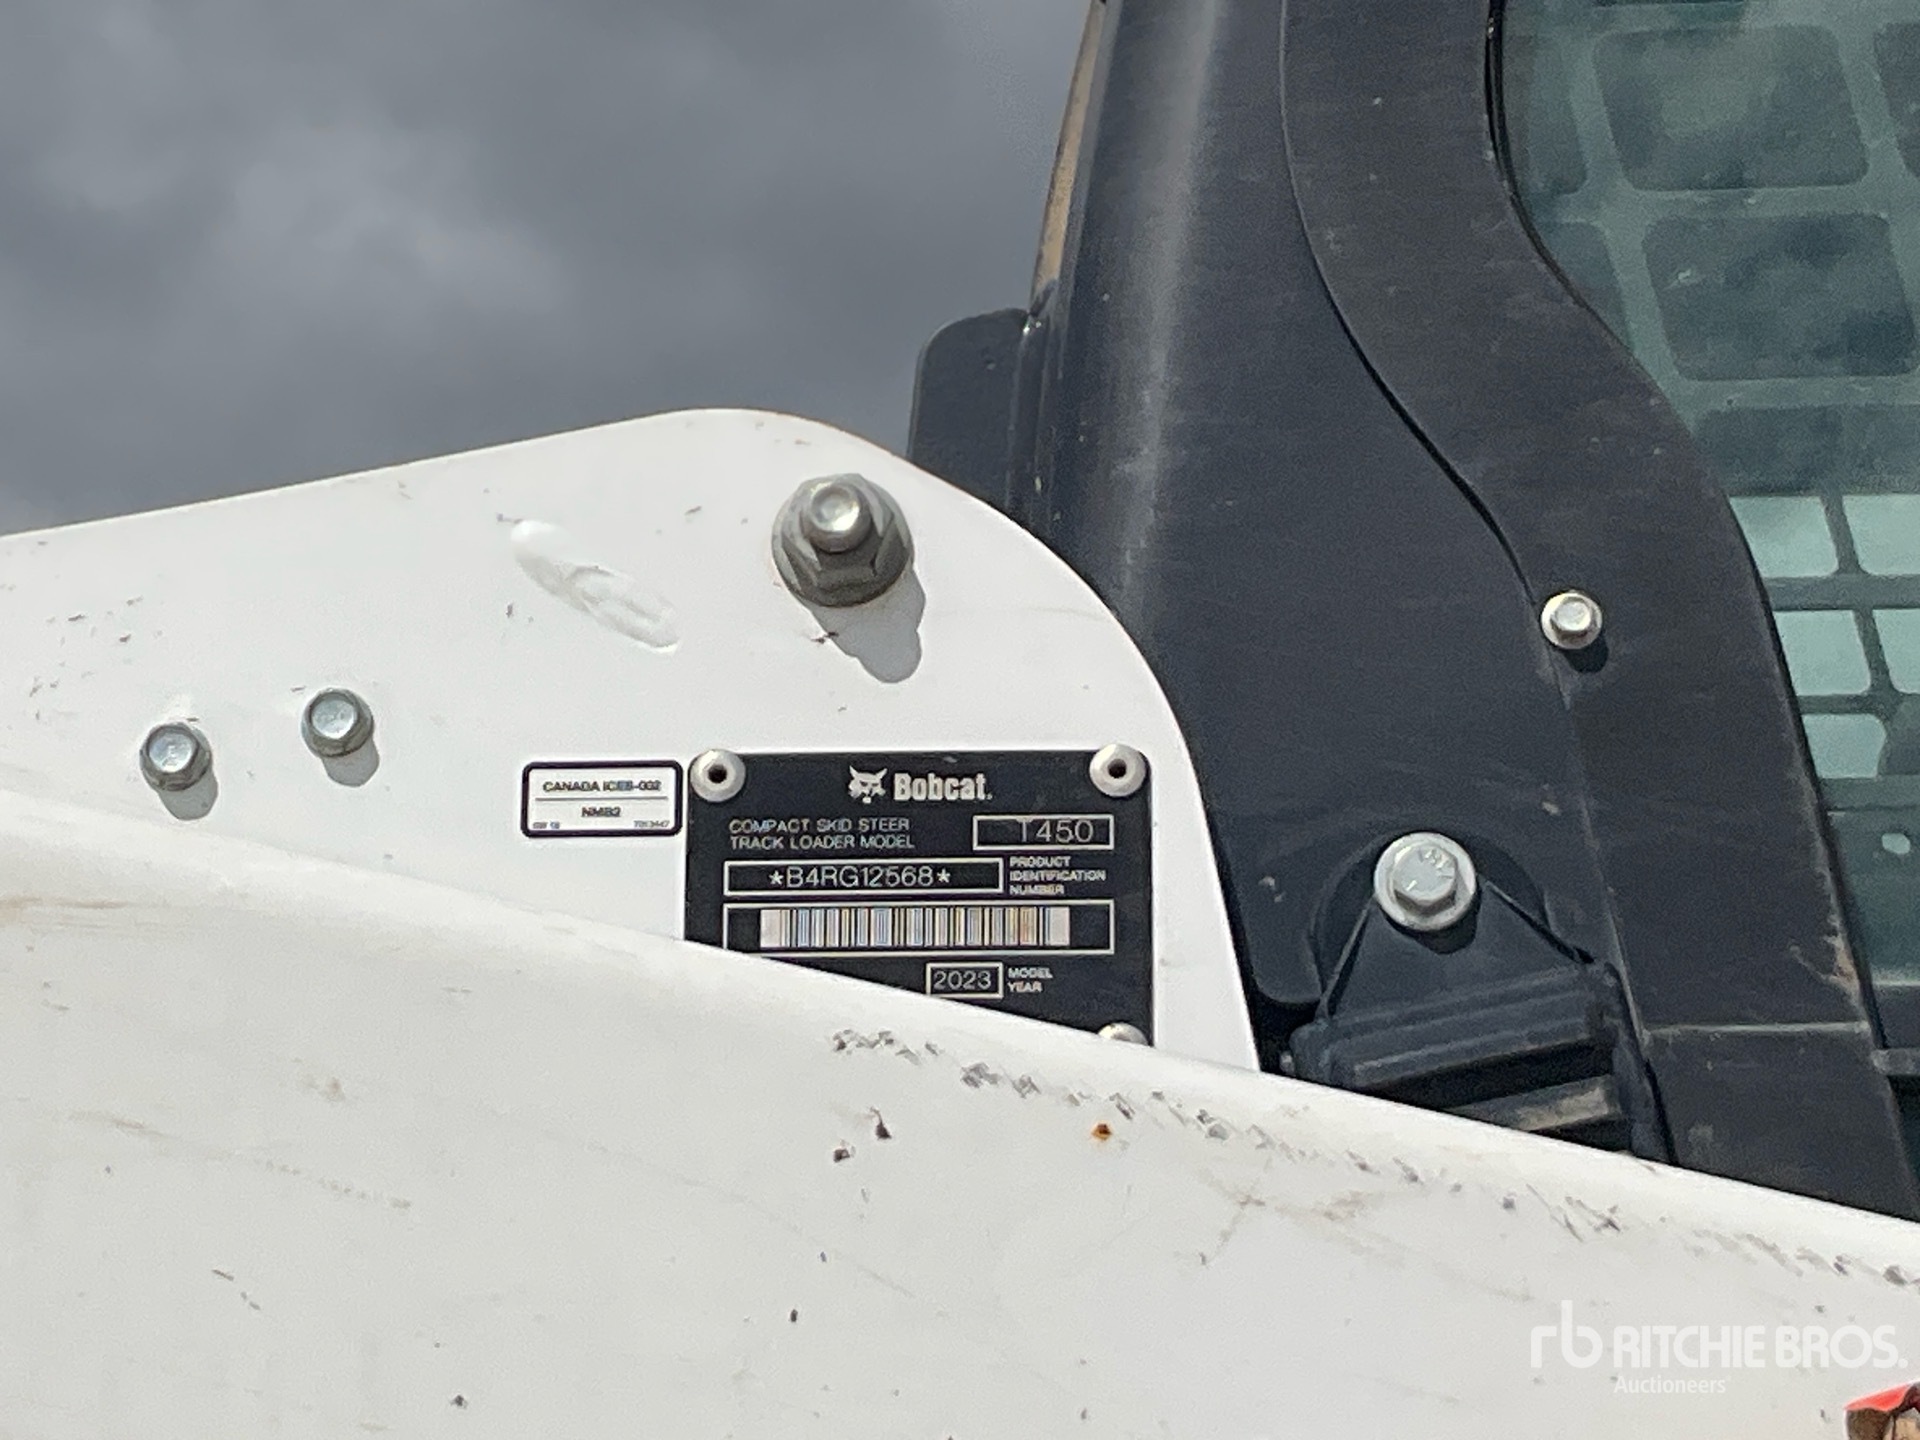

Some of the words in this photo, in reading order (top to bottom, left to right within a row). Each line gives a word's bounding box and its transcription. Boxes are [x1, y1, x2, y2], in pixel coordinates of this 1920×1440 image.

[543, 780, 600, 792] CANADA
[728, 818, 810, 835] COMPACT
[816, 818, 852, 833] SKID
[858, 817, 910, 832] STEER
[1015, 817, 1094, 844] T450
[730, 835, 784, 850] TRACK
[790, 834, 856, 850] LOADER
[860, 833, 916, 850] MODEL
[1009, 855, 1072, 868] PRODUCT
[1009, 869, 1107, 882] IDENTIFICATION
[1009, 883, 1066, 896] NUMBER
[1007, 967, 1053, 979] MODEL
[932, 969, 992, 991] 2023
[1007, 981, 1043, 993] YEAR
